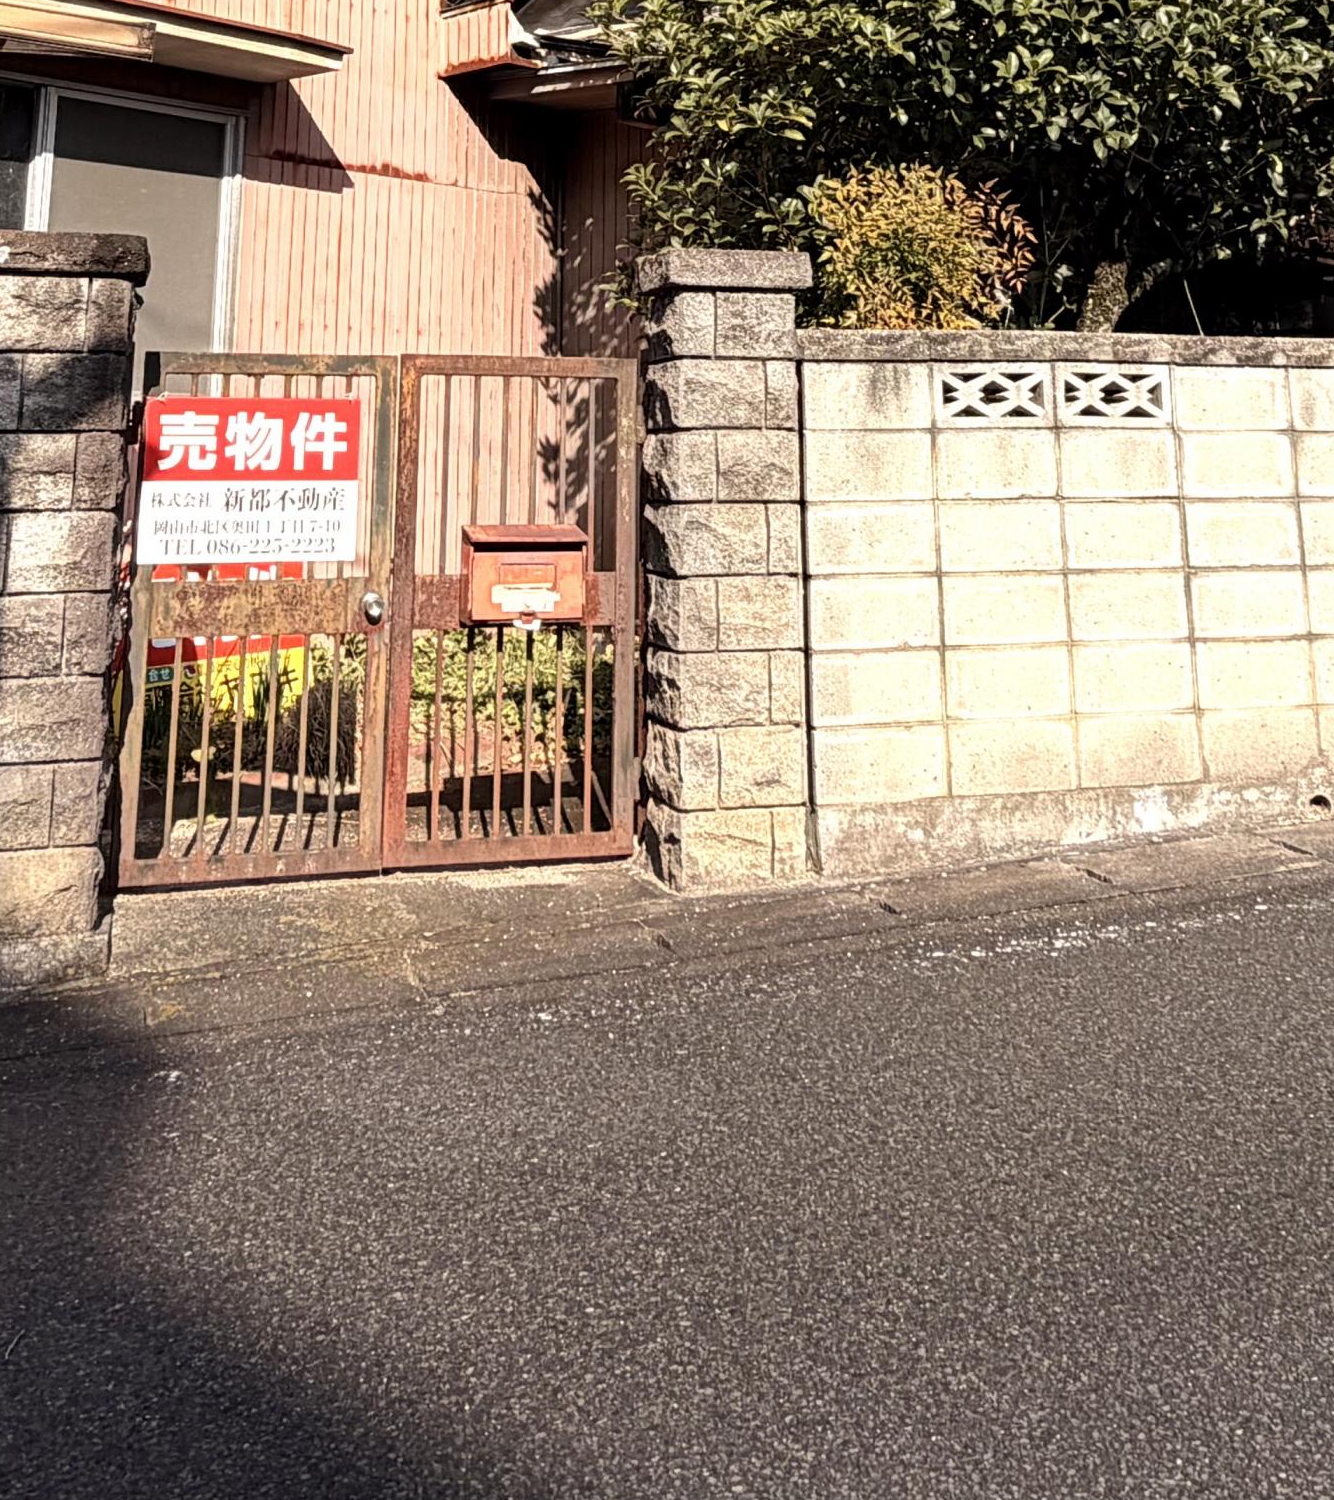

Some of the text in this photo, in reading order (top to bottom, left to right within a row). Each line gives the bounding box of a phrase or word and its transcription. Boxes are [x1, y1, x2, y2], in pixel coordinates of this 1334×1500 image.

[157, 411, 348, 471] 売物件
[151, 486, 345, 512] 株式会社 新都不動産
[160, 539, 202, 555] TEL
